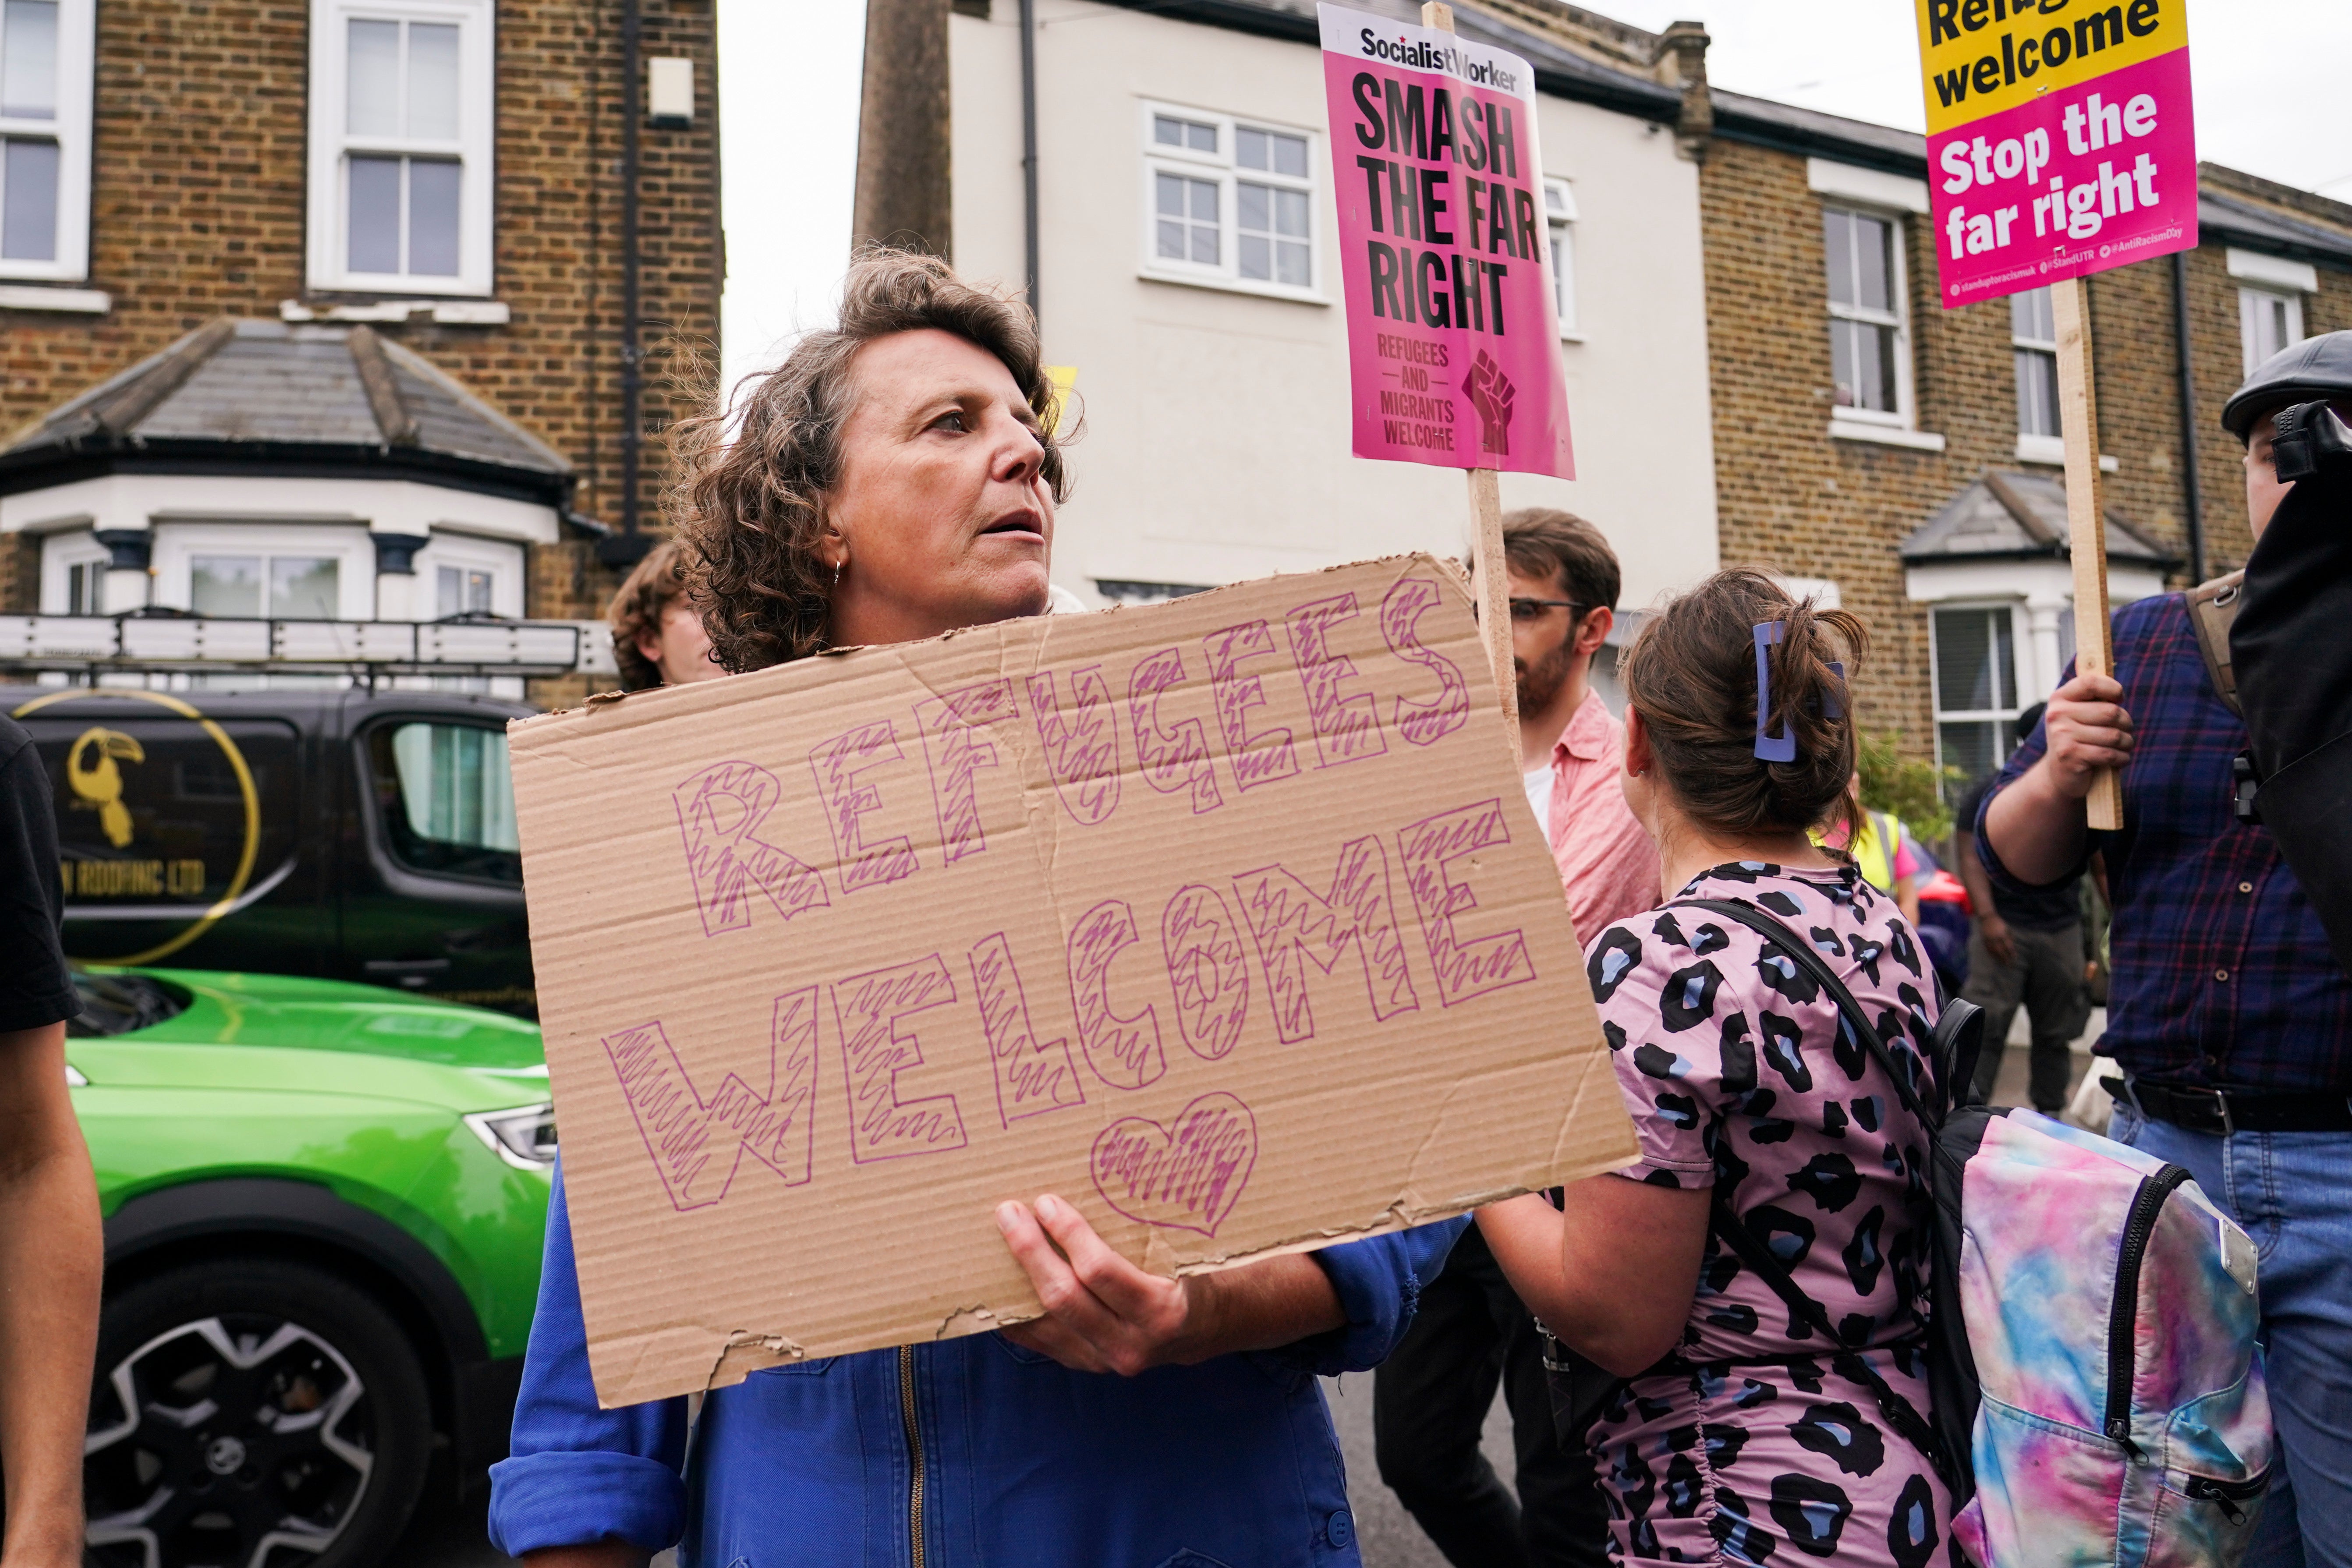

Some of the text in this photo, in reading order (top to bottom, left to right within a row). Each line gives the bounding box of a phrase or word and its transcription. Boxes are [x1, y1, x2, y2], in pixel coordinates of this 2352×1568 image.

[1933, 0, 2160, 108] welcome
[1352, 72, 1517, 179] SMASH
[1940, 92, 2158, 195] Stop the
[1356, 154, 1541, 264] THE FAR
[1945, 153, 2160, 260] far right
[1367, 240, 1508, 336] RIGHT
[1377, 333, 1449, 367] REFUGEES
[1402, 365, 1429, 392] AND
[1380, 390, 1455, 424] MIGRANTS
[1384, 419, 1455, 451] WELCOME
[672, 578, 1470, 936] REFUGEES
[167, 858, 205, 895] LTD
[601, 798, 1536, 1212] WELCOME
